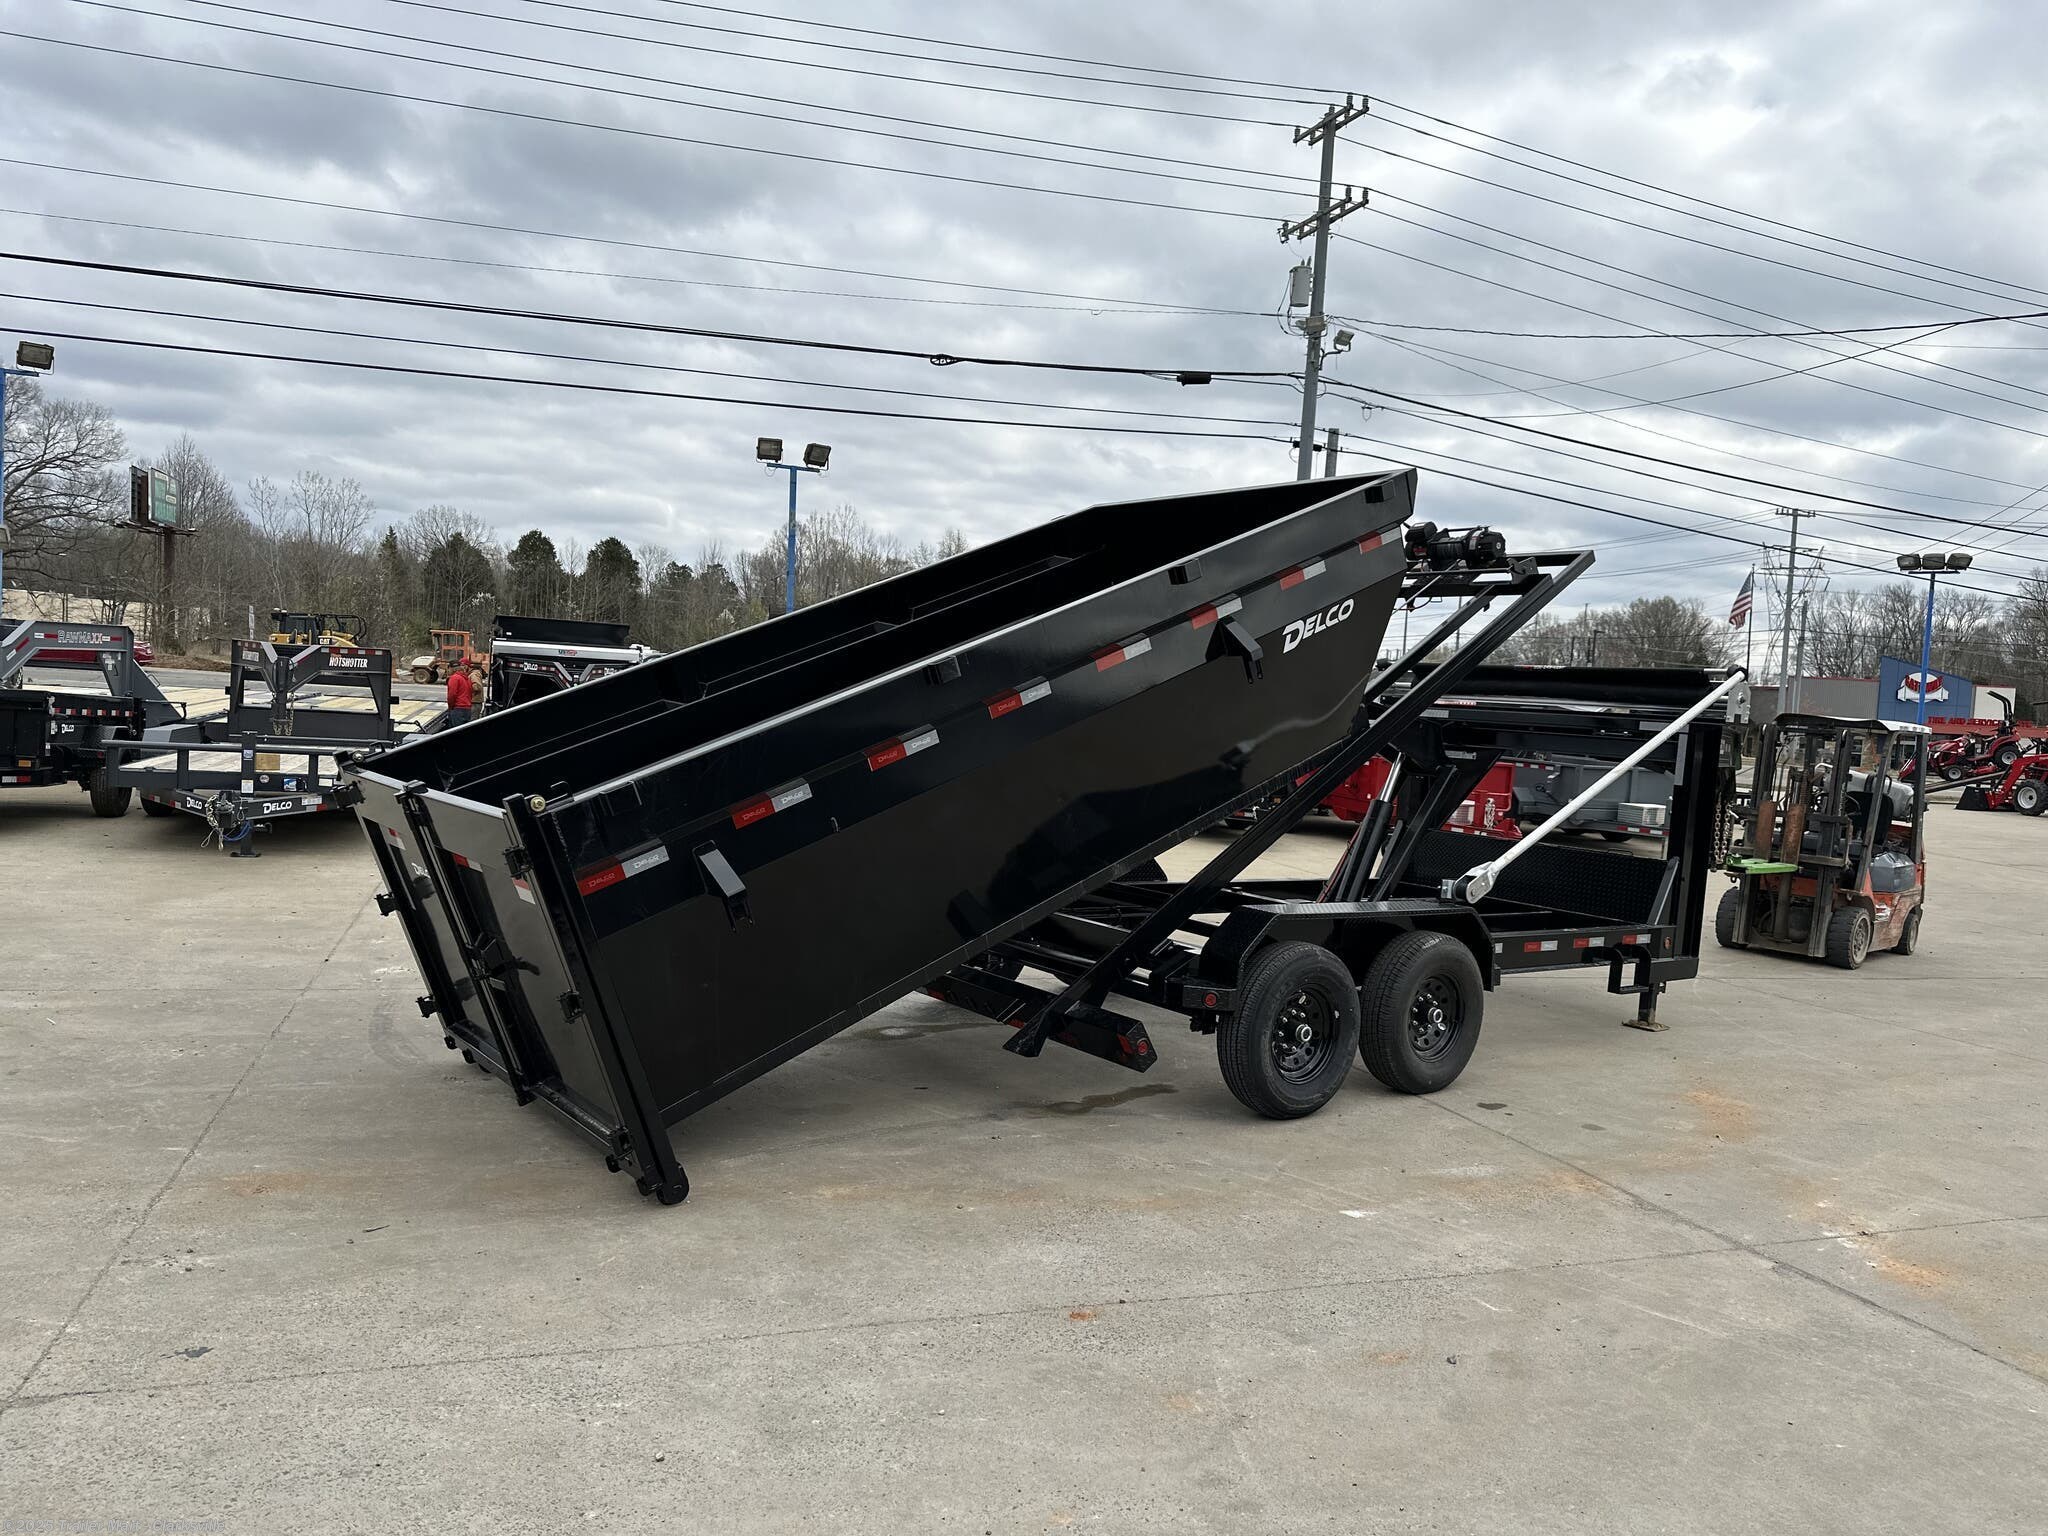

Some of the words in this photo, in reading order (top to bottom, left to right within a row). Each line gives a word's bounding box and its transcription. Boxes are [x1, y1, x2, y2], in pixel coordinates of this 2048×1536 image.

[1281, 598, 1354, 654] DELCO
[328, 657, 368, 669] HOTSHOTTER
[184, 796, 203, 810] DELCO
[261, 801, 291, 814] DELCO
